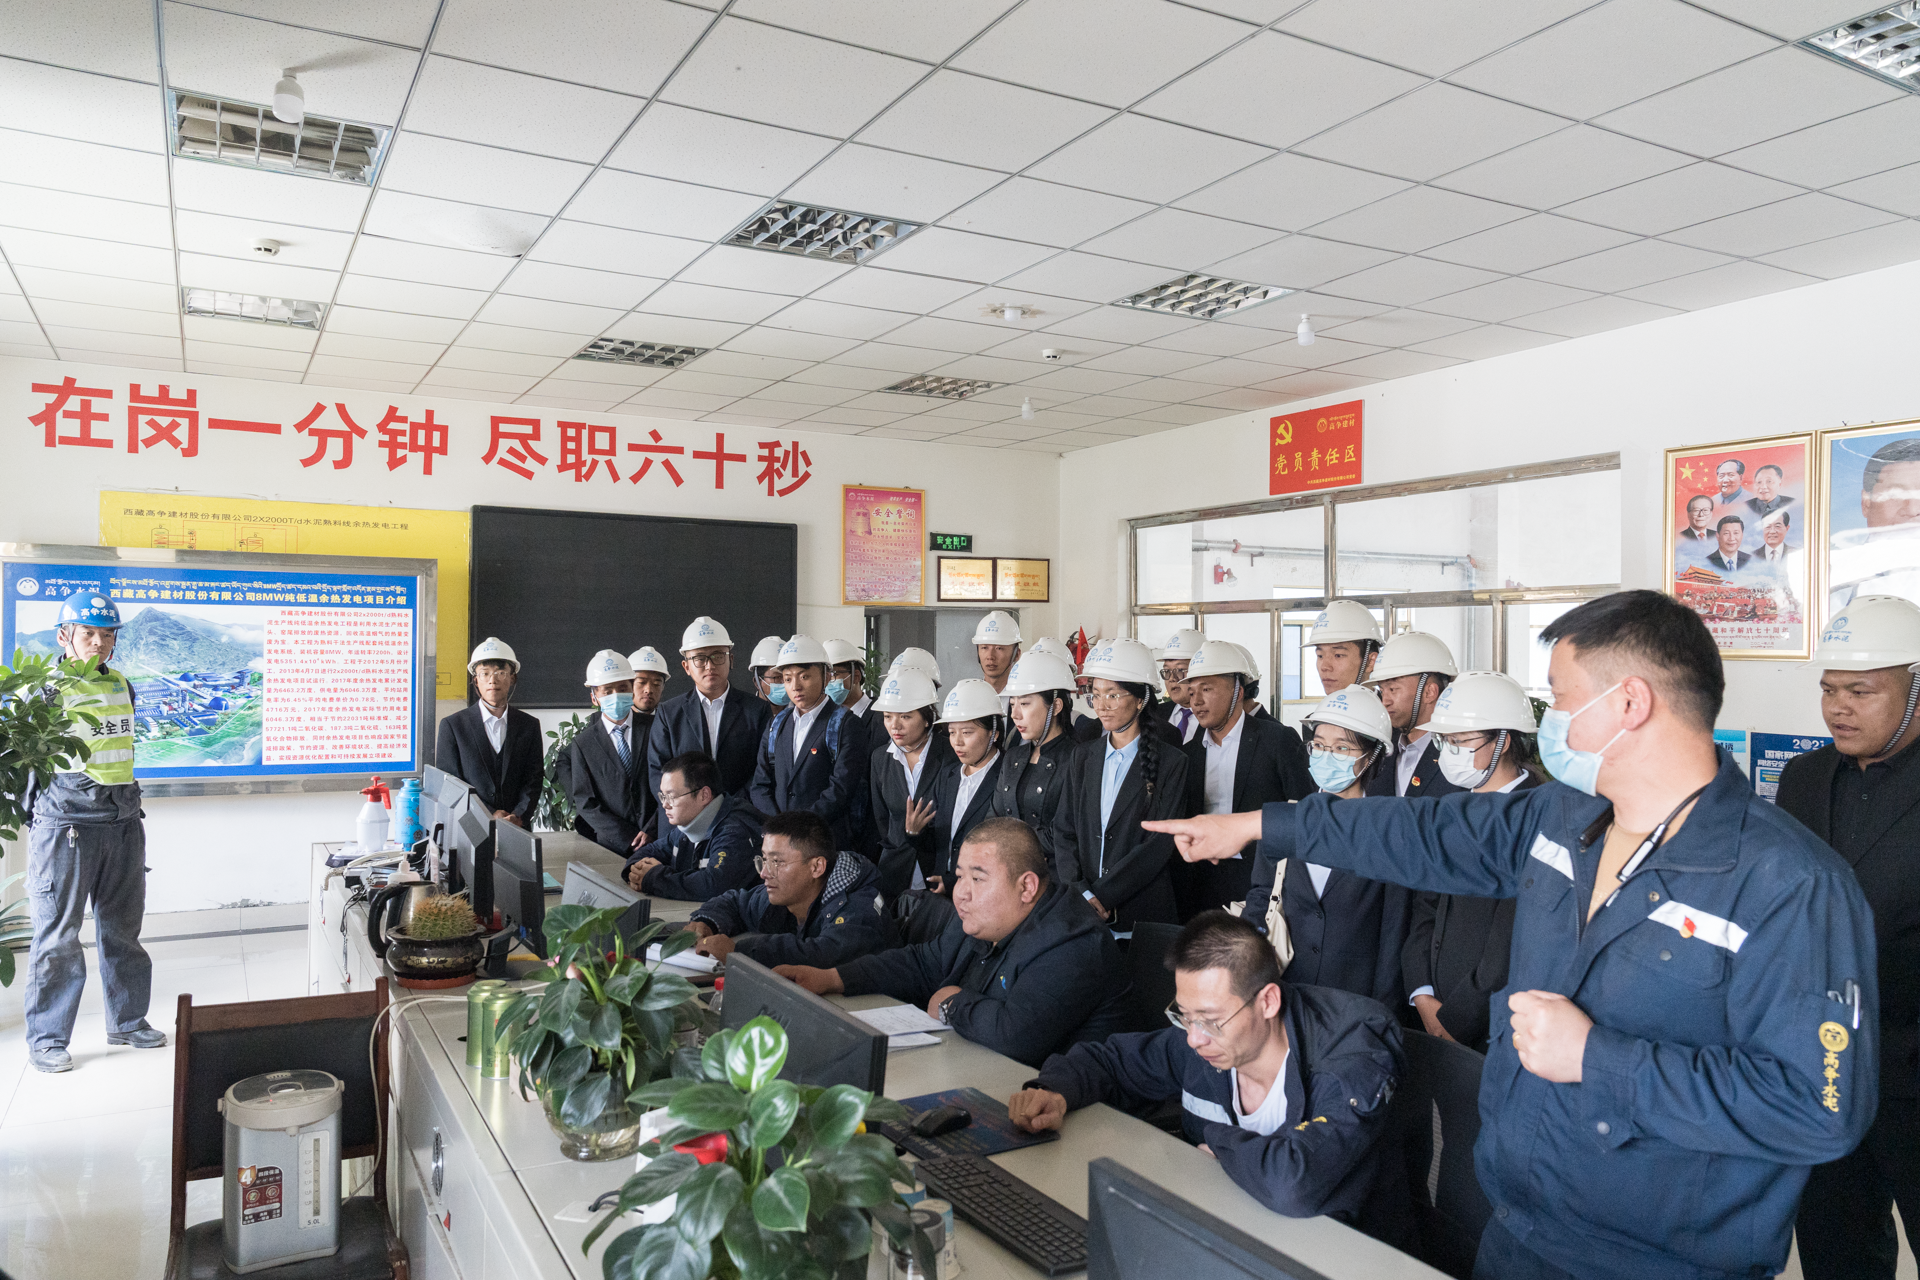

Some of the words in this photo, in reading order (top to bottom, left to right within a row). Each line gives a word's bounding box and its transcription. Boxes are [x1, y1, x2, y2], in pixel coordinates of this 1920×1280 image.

[28, 375, 449, 475] 在岗一分钟
[481, 415, 813, 497] 尽职六十秒
[1275, 444, 1356, 475] 党员责任区
[123, 508, 409, 530] 西藏高争建材股份有限公司2X2000T/d水泥熟料线余热发电工程
[936, 535, 967, 546] 安全出口
[110, 588, 407, 605] 西藏高争建材股份有限公司8MW纯低温余热发电项目介绍
[80, 608, 116, 618] 高争水泥
[1709, 626, 1789, 634] 藏和平解放七十周年
[91, 718, 131, 737] 安全员
[240, 1169, 252, 1185] 4
